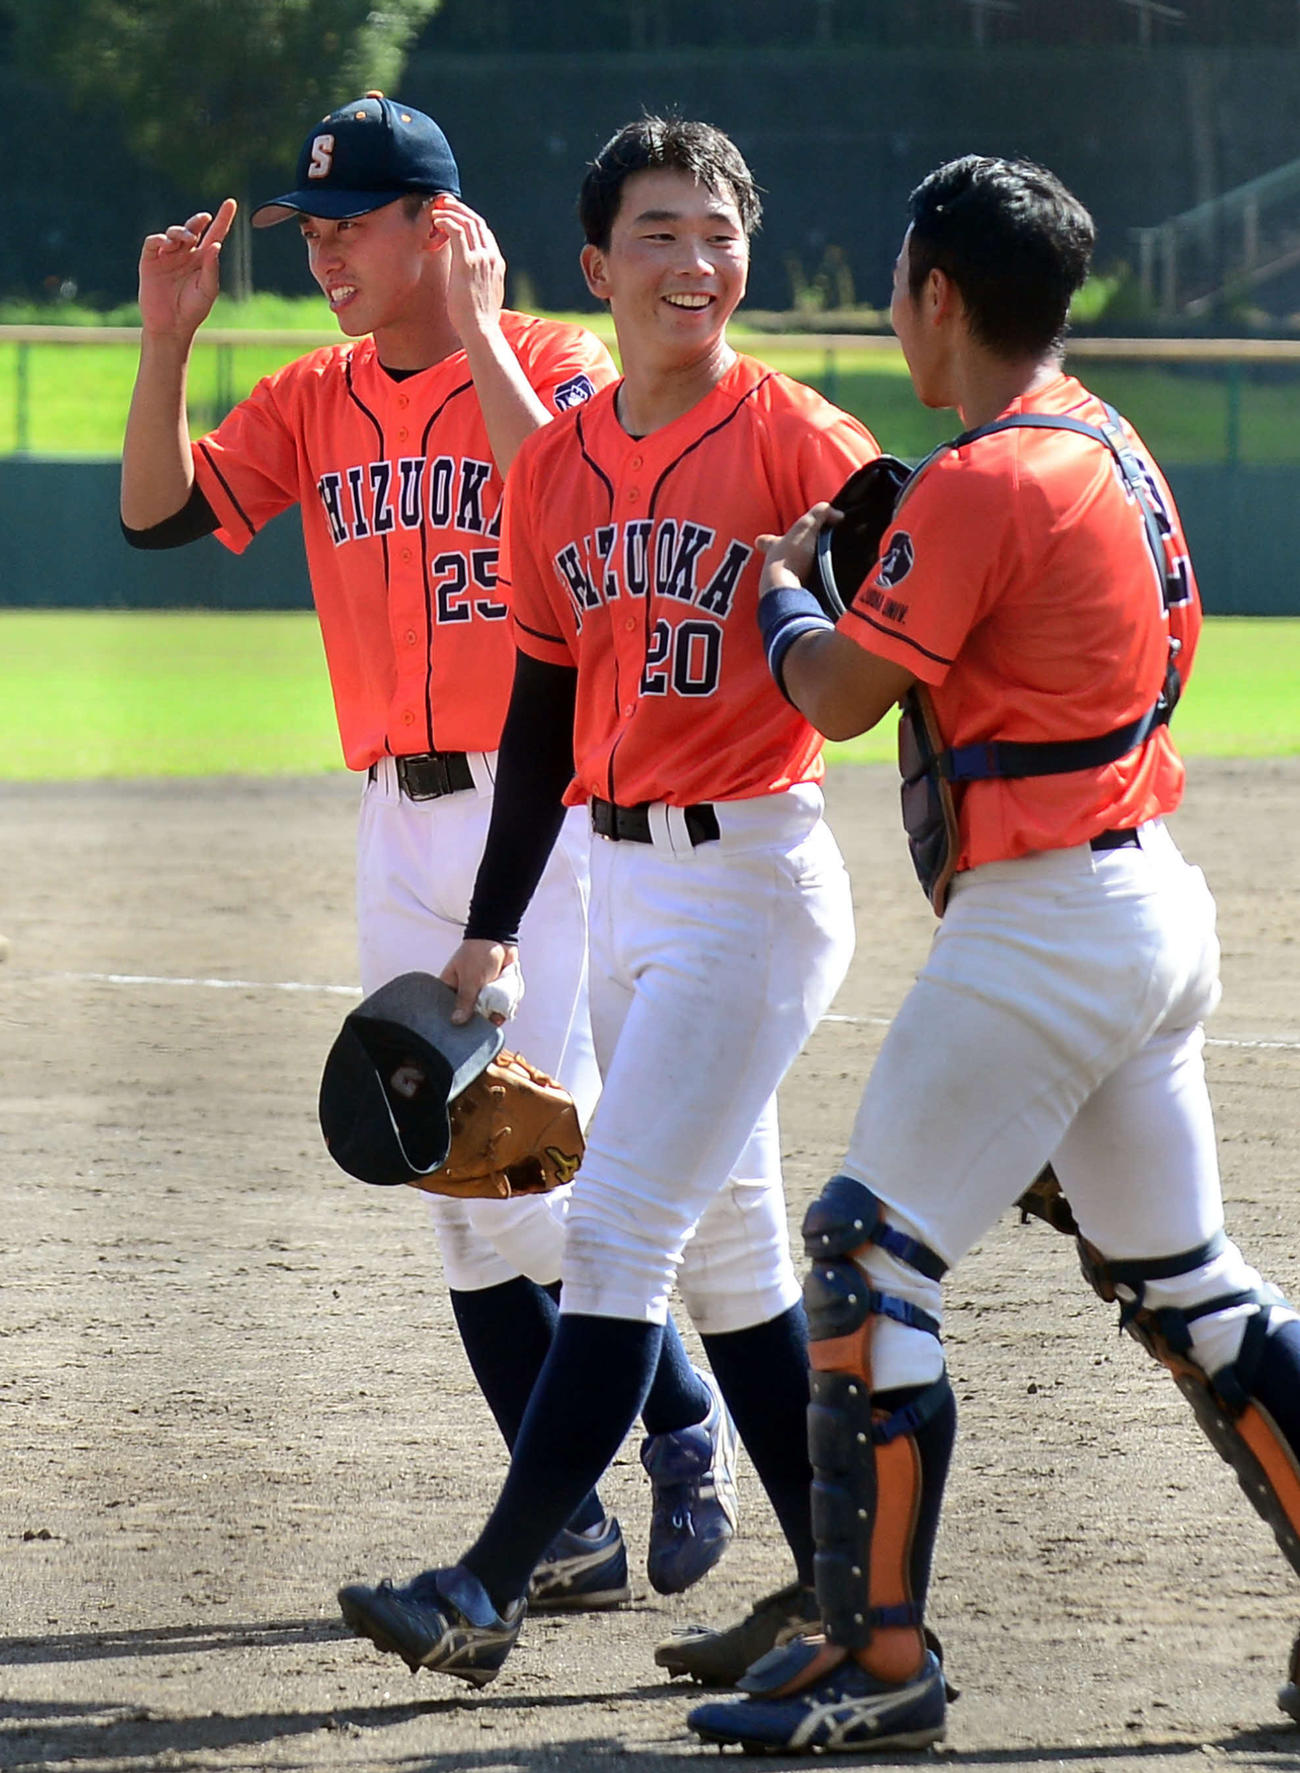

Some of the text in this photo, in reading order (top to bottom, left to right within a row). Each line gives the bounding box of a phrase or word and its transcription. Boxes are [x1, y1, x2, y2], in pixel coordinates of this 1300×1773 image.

[308, 134, 335, 179] S
[432, 548, 508, 625] 25
[552, 518, 753, 636] HIZUOKA
[638, 618, 723, 698] 20
